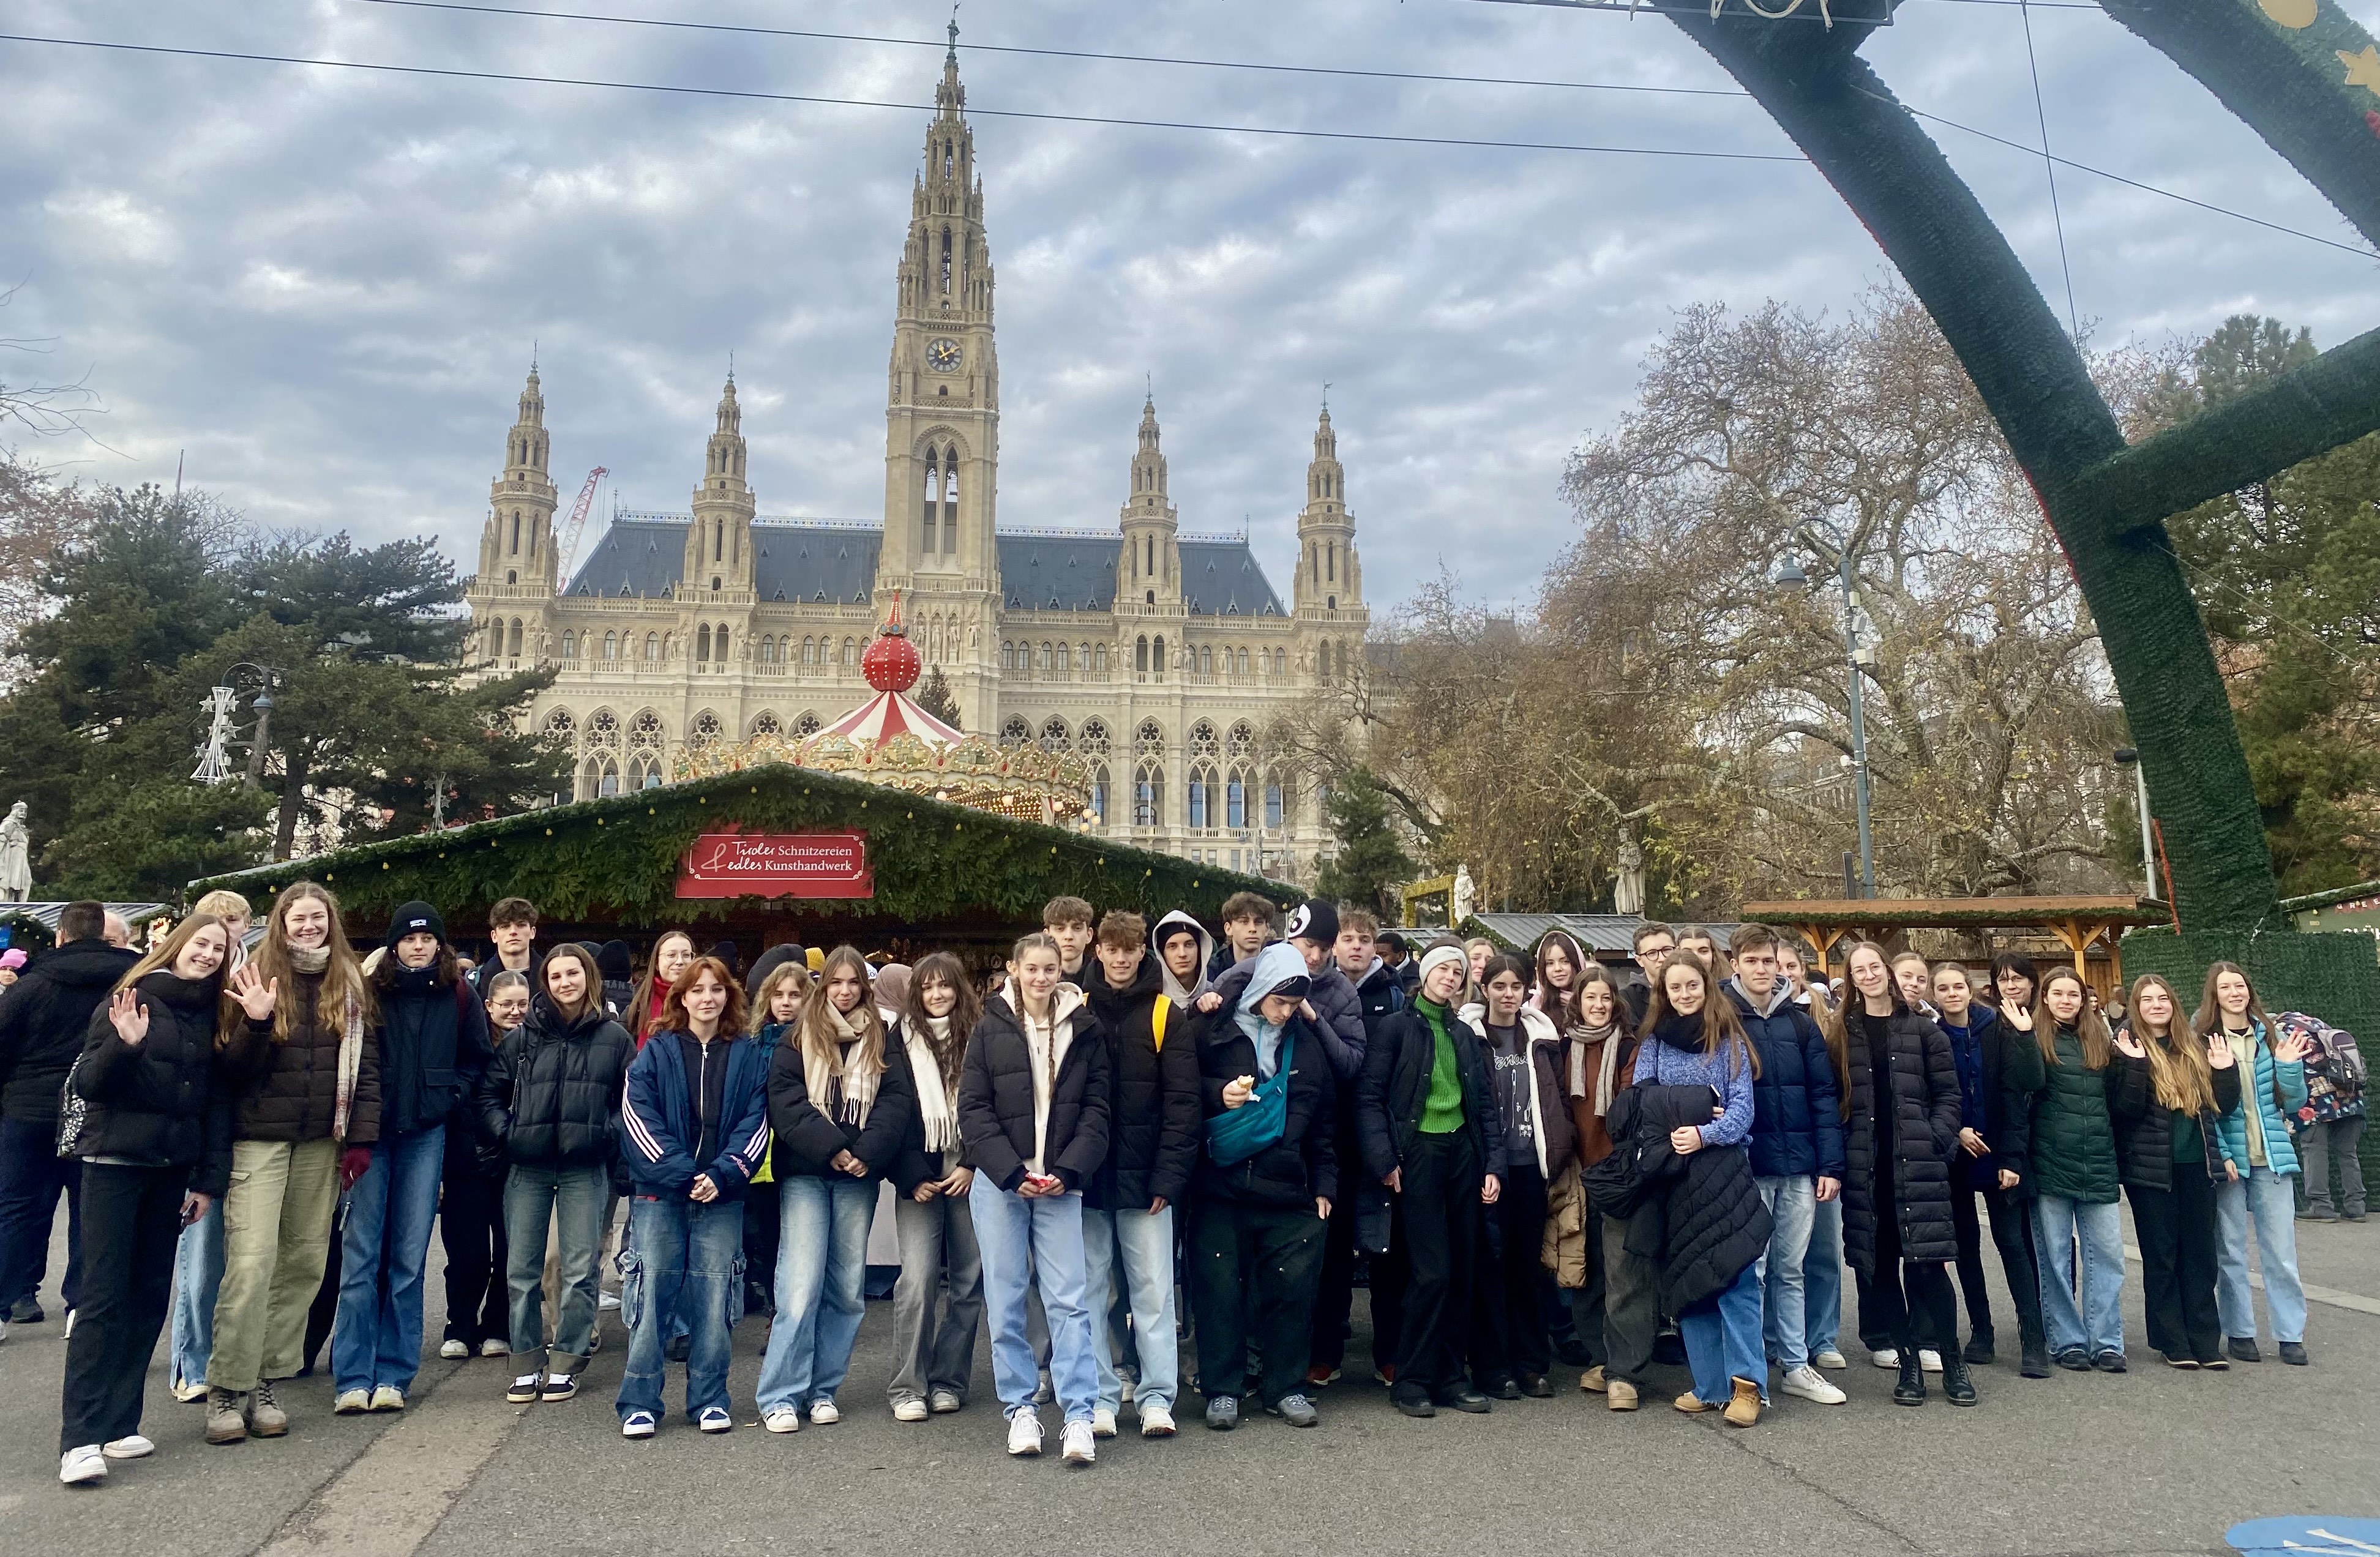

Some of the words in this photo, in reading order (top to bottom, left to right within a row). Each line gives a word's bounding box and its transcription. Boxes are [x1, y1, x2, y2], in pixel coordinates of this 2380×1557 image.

[731, 841, 776, 856] Tiroler
[778, 845, 852, 856] Schnitzereien
[727, 856, 762, 870] edles
[765, 860, 852, 871] Kunsthandwerk
